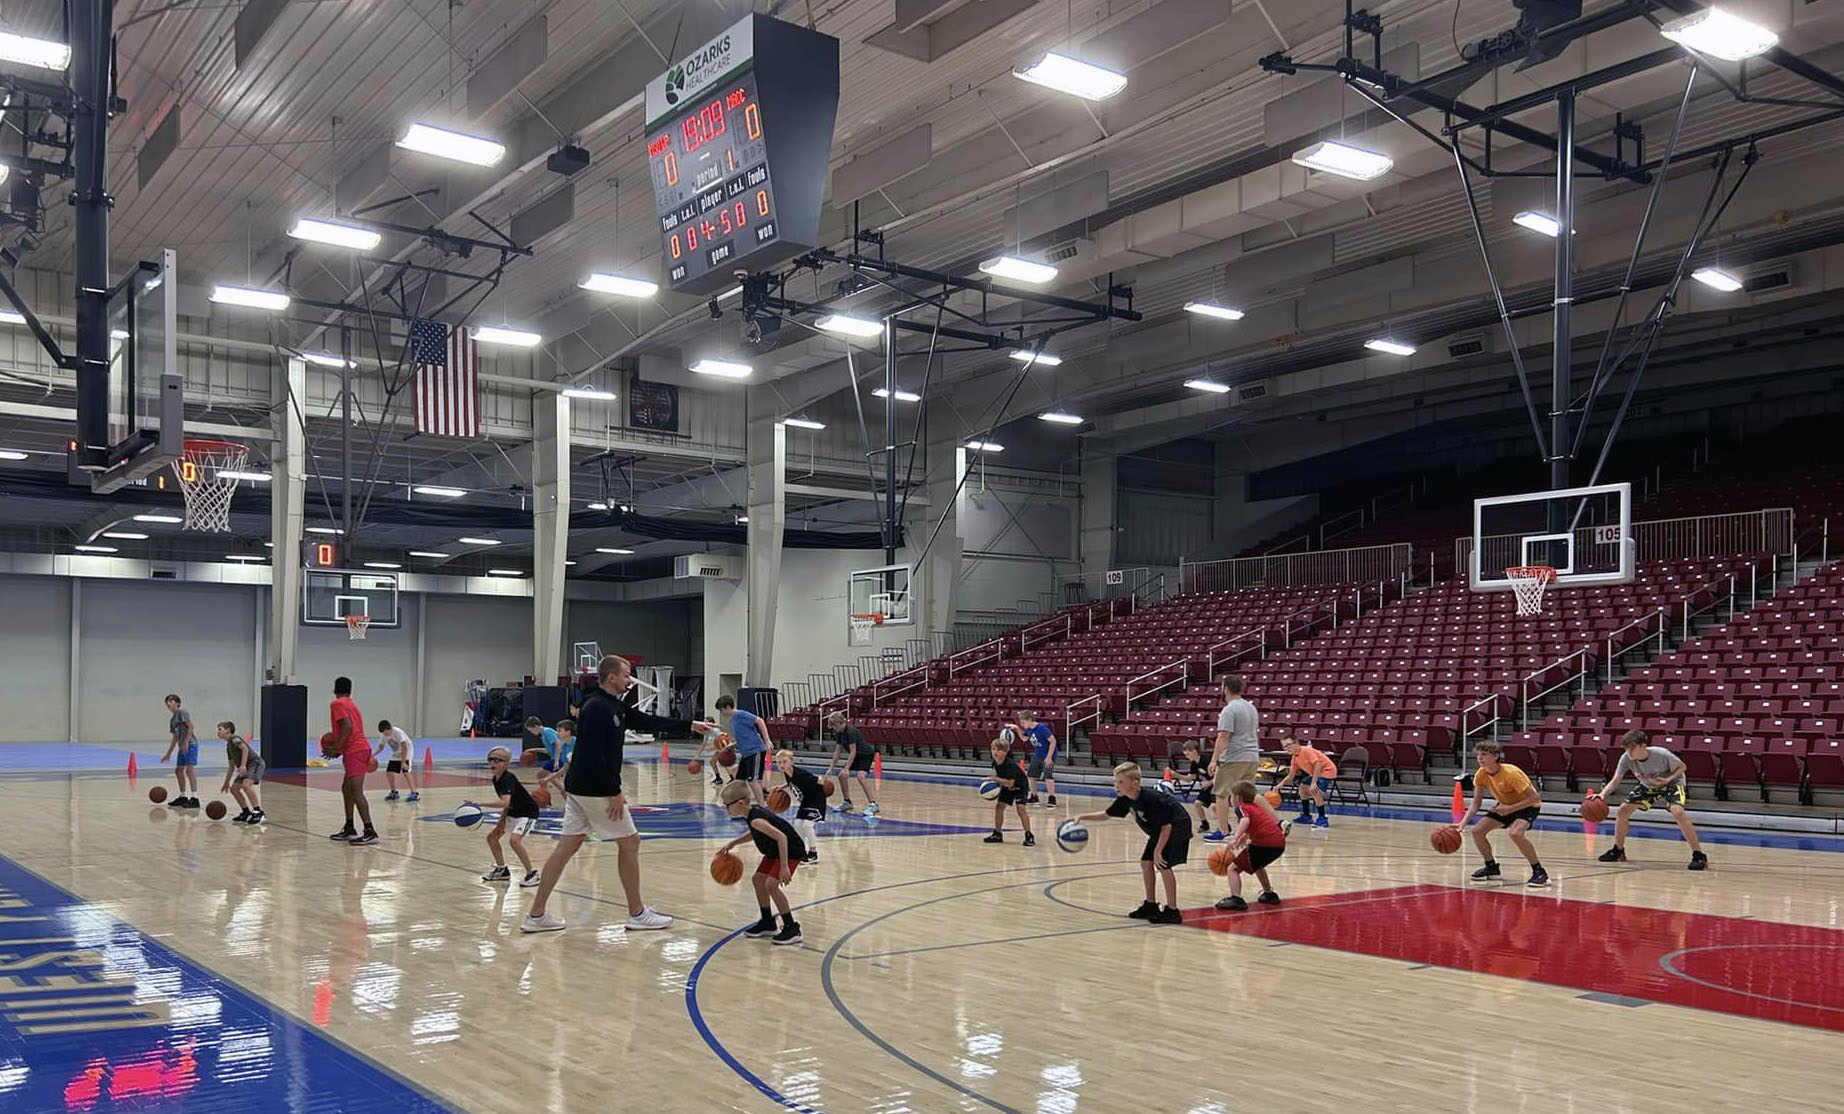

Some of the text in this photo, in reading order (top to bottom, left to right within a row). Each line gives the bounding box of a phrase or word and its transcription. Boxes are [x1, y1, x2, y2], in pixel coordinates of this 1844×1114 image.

[686, 35, 731, 76] OZARKS
[686, 52, 731, 92] HEALTHCARE
[682, 100, 725, 151] 19:09
[745, 103, 760, 140] 0
[664, 152, 678, 186] 0
[696, 161, 719, 189] period
[662, 213, 678, 231] fouls
[701, 189, 722, 213] player
[747, 166, 765, 187] fouls
[711, 245, 729, 266] game
[1598, 528, 1620, 541] 105
[319, 544, 331, 565] 0
[1107, 572, 1121, 583] 109
